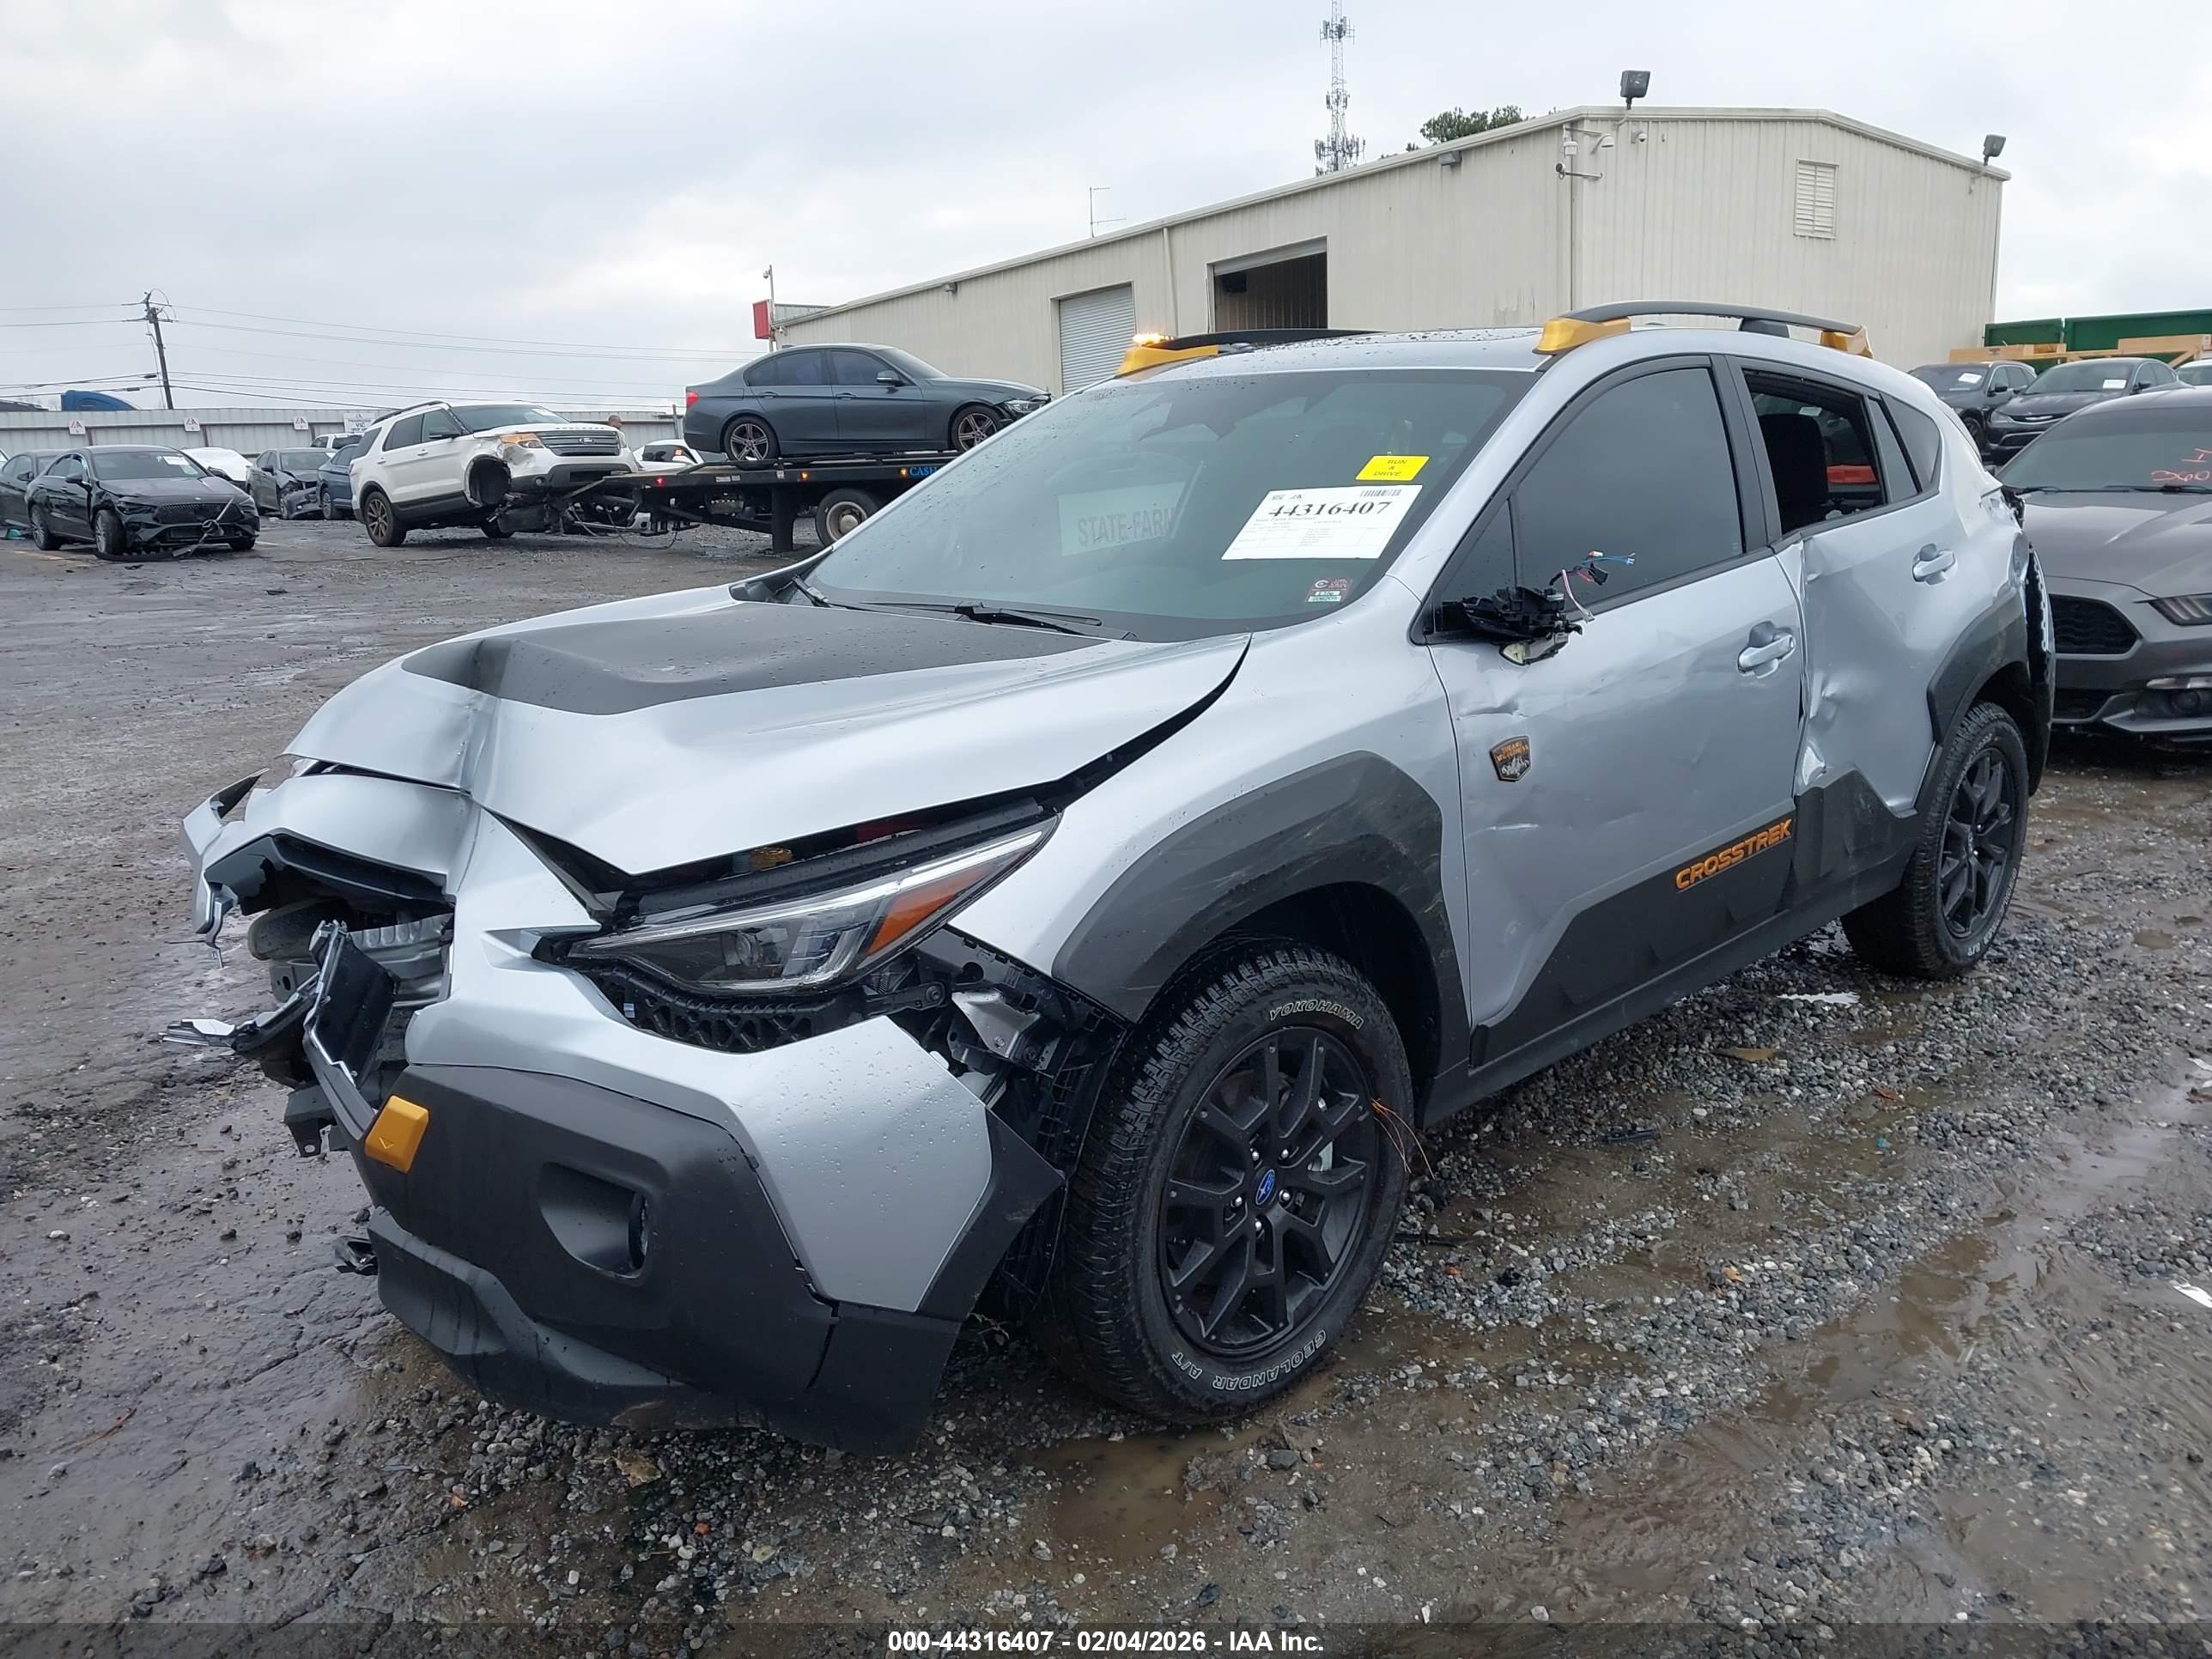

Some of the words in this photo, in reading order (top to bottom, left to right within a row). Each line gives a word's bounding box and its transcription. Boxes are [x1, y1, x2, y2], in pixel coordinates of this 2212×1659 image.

[1267, 501, 1394, 517] 44316407
[1675, 818, 1793, 890] CROSSTREK
[1269, 999, 1364, 1030] YOKOHAMA
[1171, 1352, 1203, 1380] A/T
[1212, 1329, 1327, 1391] GEOLANDAR
